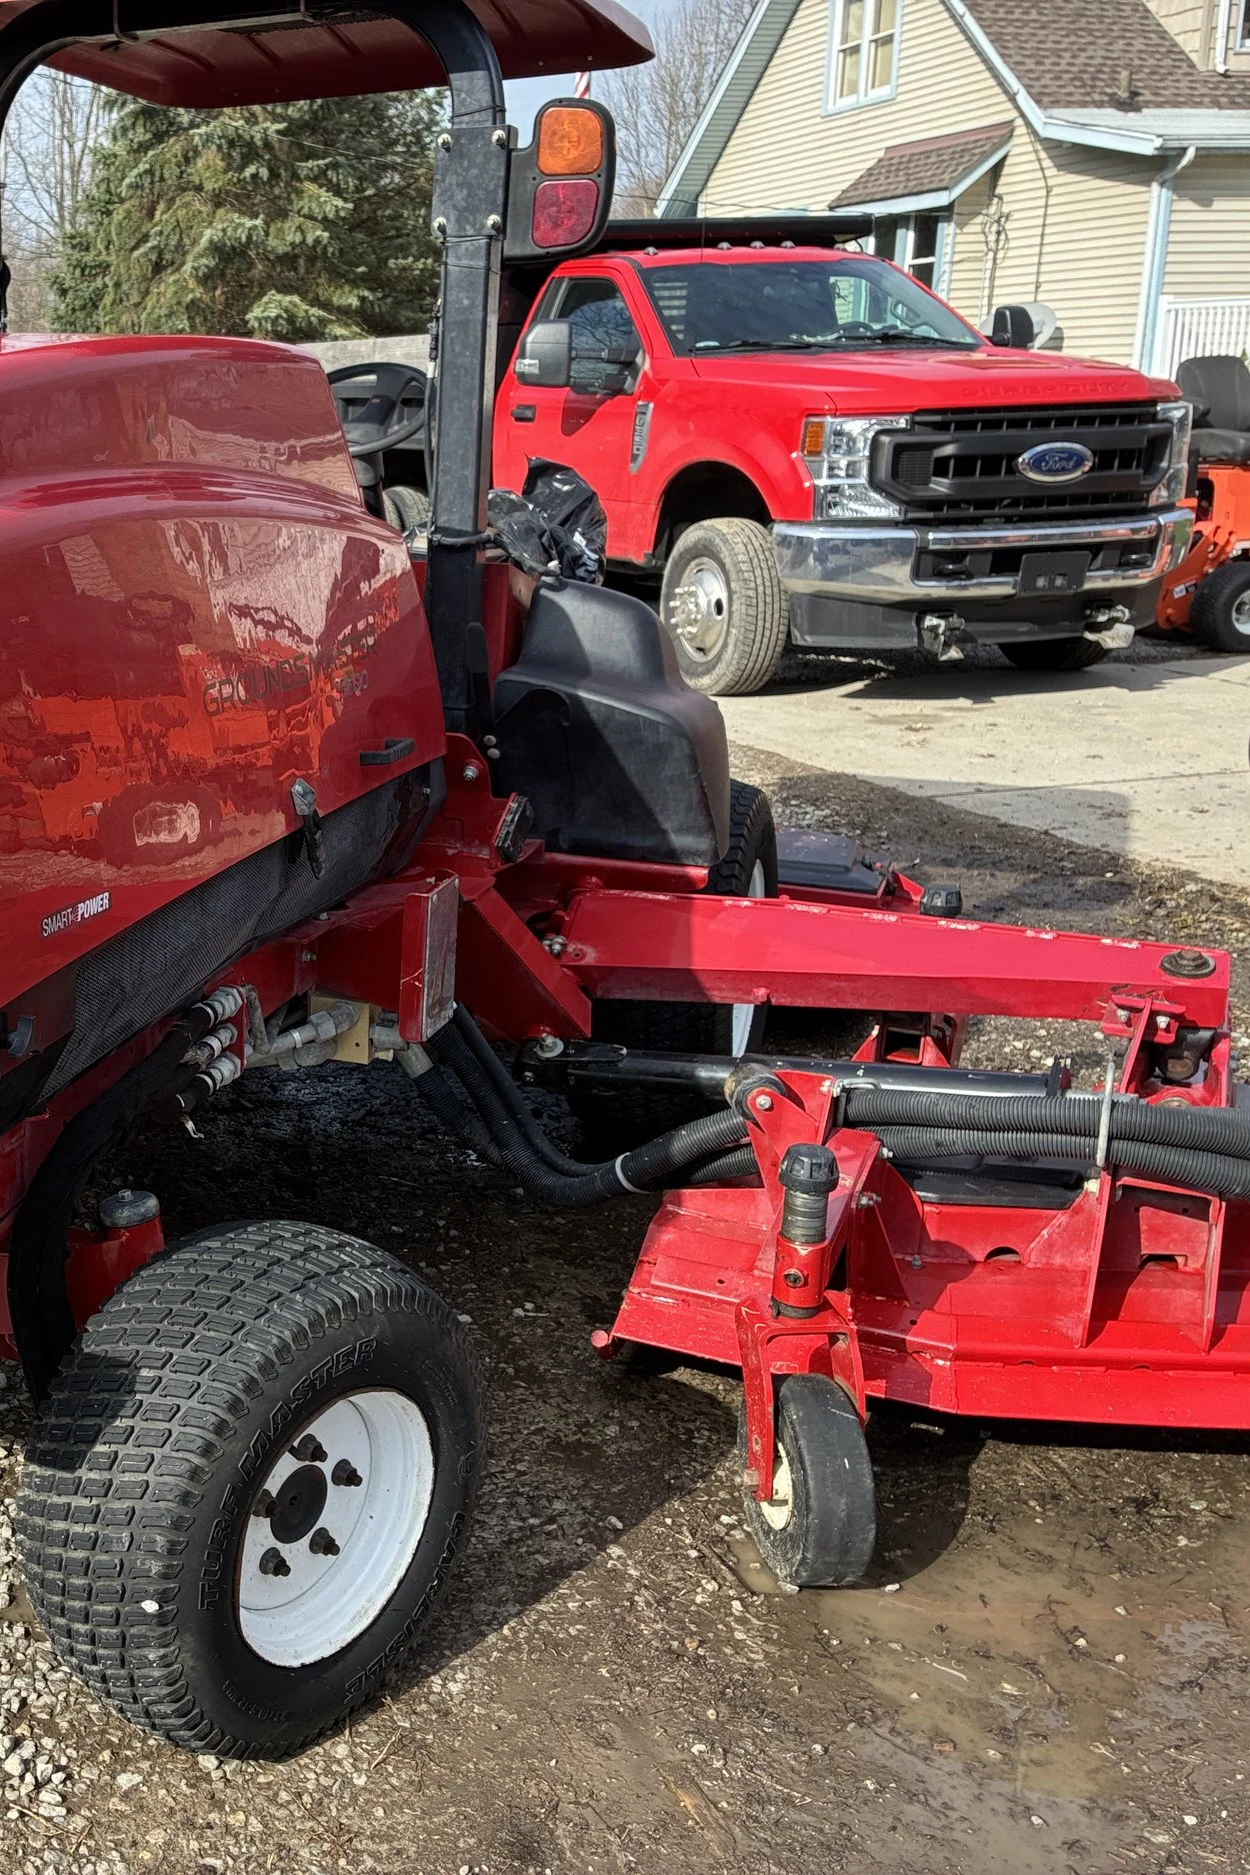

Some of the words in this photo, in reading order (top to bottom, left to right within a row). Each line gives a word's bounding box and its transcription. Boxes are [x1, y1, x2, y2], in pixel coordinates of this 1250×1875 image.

[1041, 452, 1077, 471] Ford
[203, 630, 378, 717] GROUNDSMASTER
[77, 892, 109, 922] POWER
[198, 1483, 240, 1610] TURF
[238, 1336, 377, 1478] MASTER
[344, 1511, 467, 1705] CARLISLE
